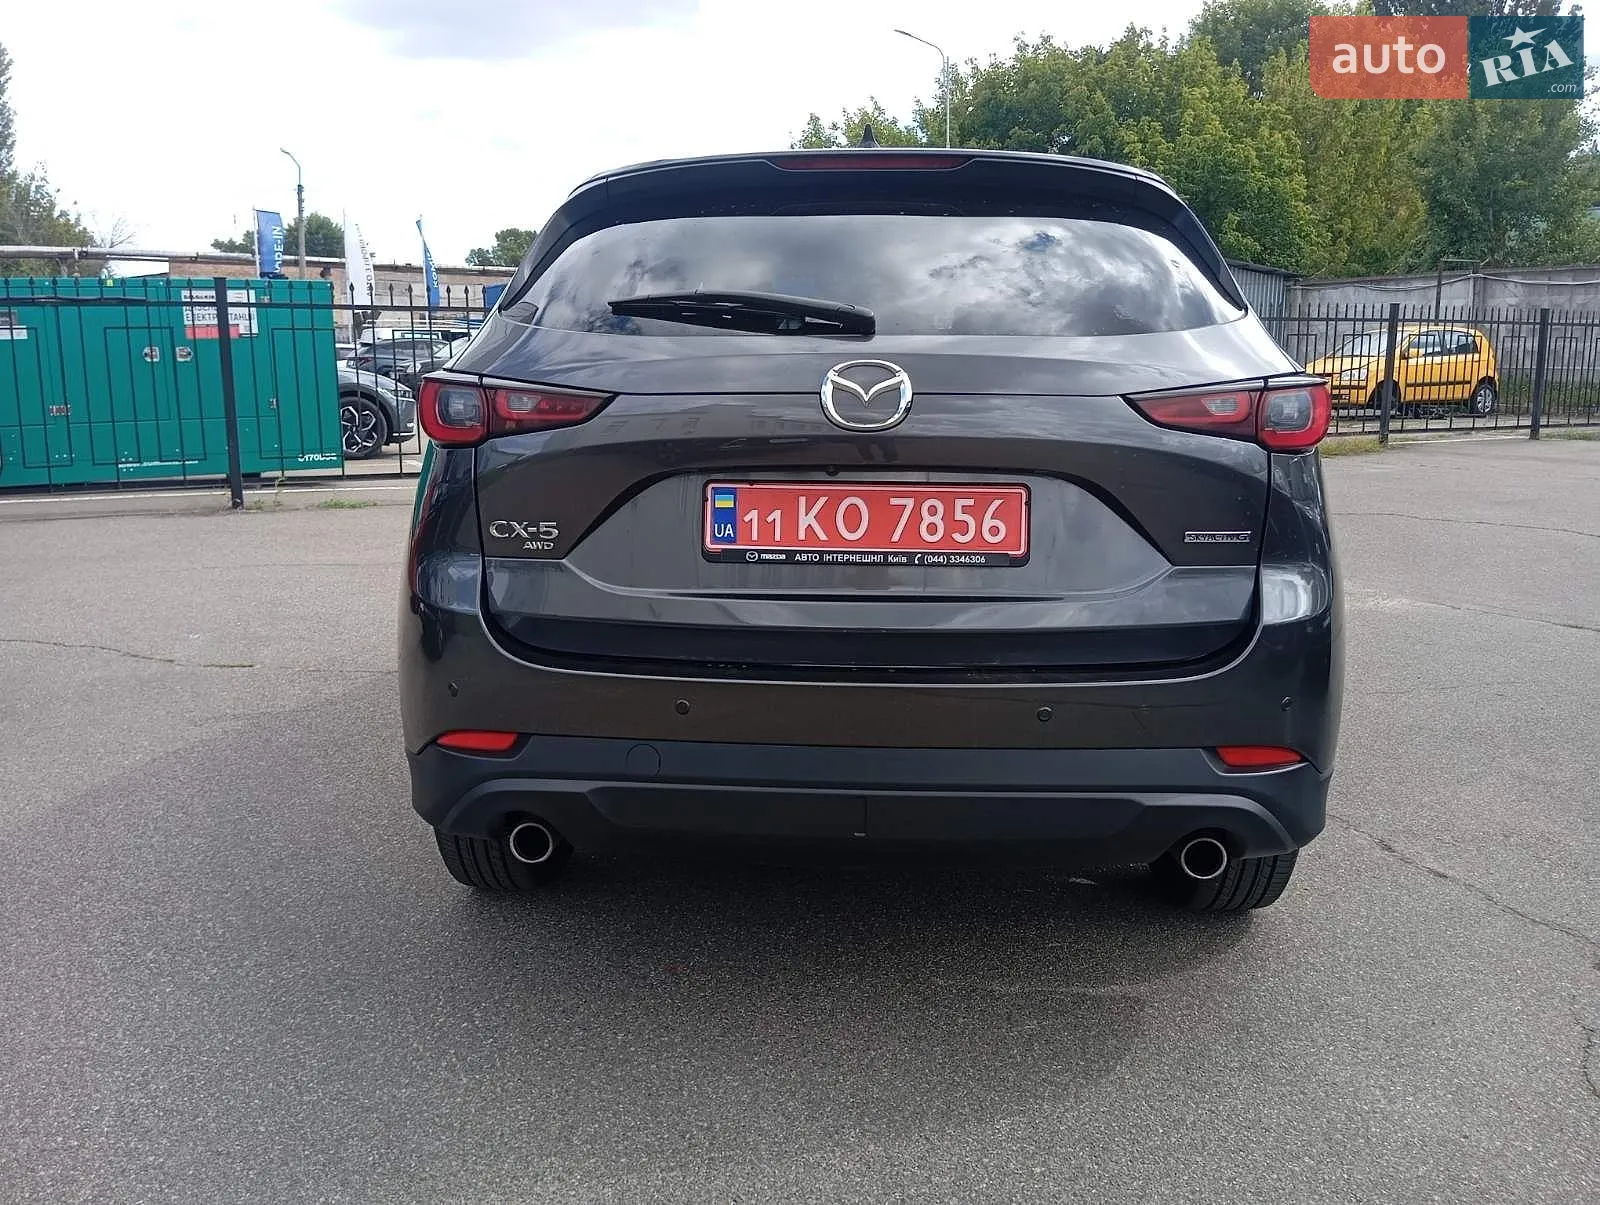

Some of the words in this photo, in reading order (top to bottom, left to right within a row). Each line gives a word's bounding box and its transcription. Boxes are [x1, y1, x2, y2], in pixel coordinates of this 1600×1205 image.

[743, 509, 782, 542] 11
[797, 495, 869, 541] KO
[889, 497, 1007, 544] 7856
[489, 520, 559, 539] CX-5
[714, 523, 734, 538] UA
[522, 541, 554, 550] AWD
[760, 552, 786, 560] mazda
[794, 552, 820, 562] АВТО
[887, 554, 908, 564] Київ
[924, 554, 947, 565] (044)
[949, 554, 986, 564] 3346306
